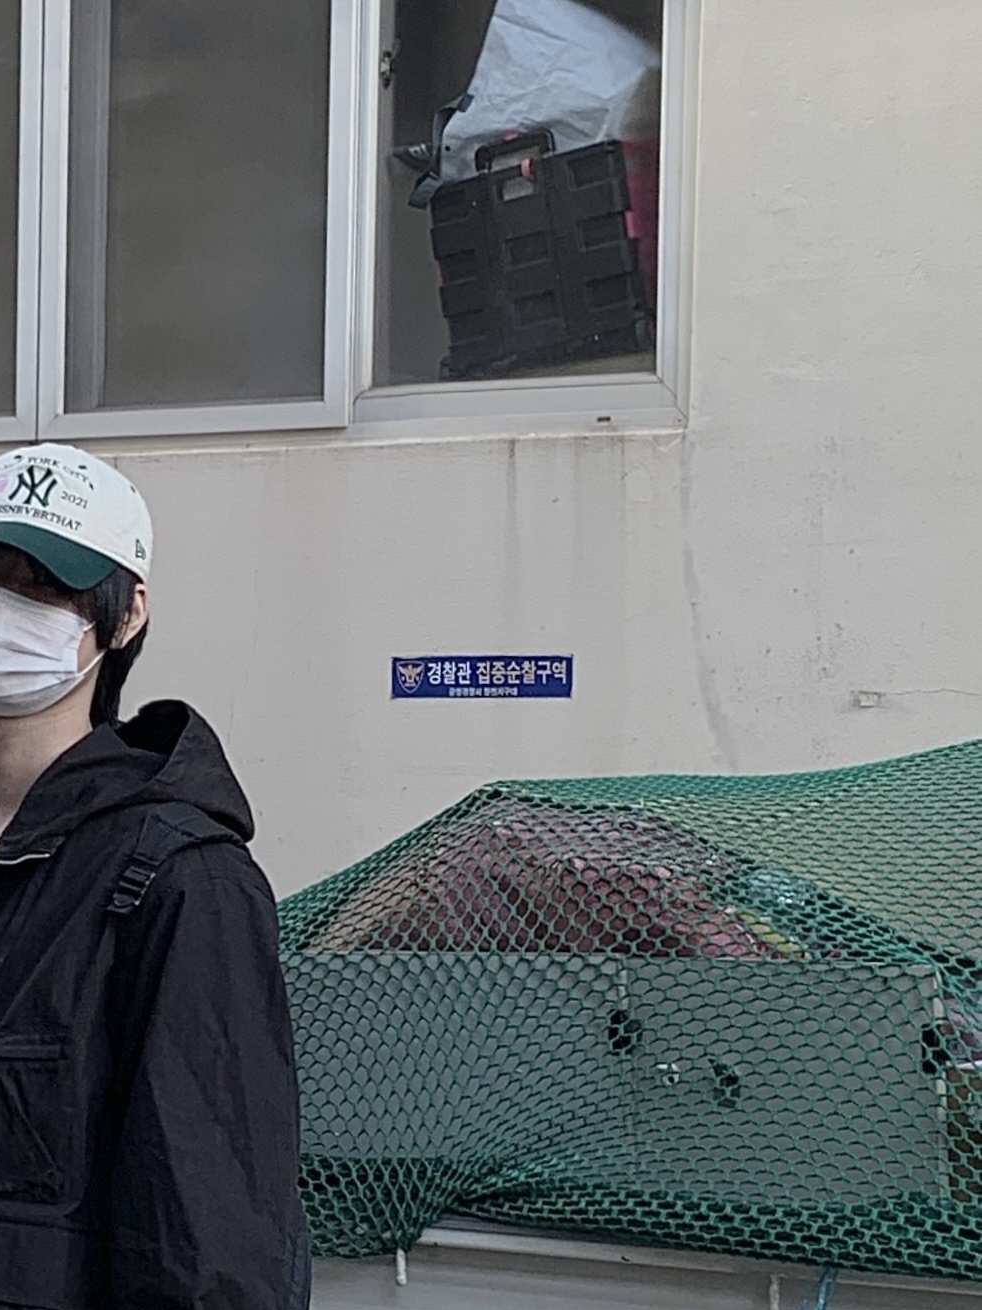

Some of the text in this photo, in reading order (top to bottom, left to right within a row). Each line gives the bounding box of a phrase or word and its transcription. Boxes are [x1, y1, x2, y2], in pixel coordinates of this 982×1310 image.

[61, 491, 89, 509] 2021
[427, 661, 567, 685] 경찰관 집중순찰구역
